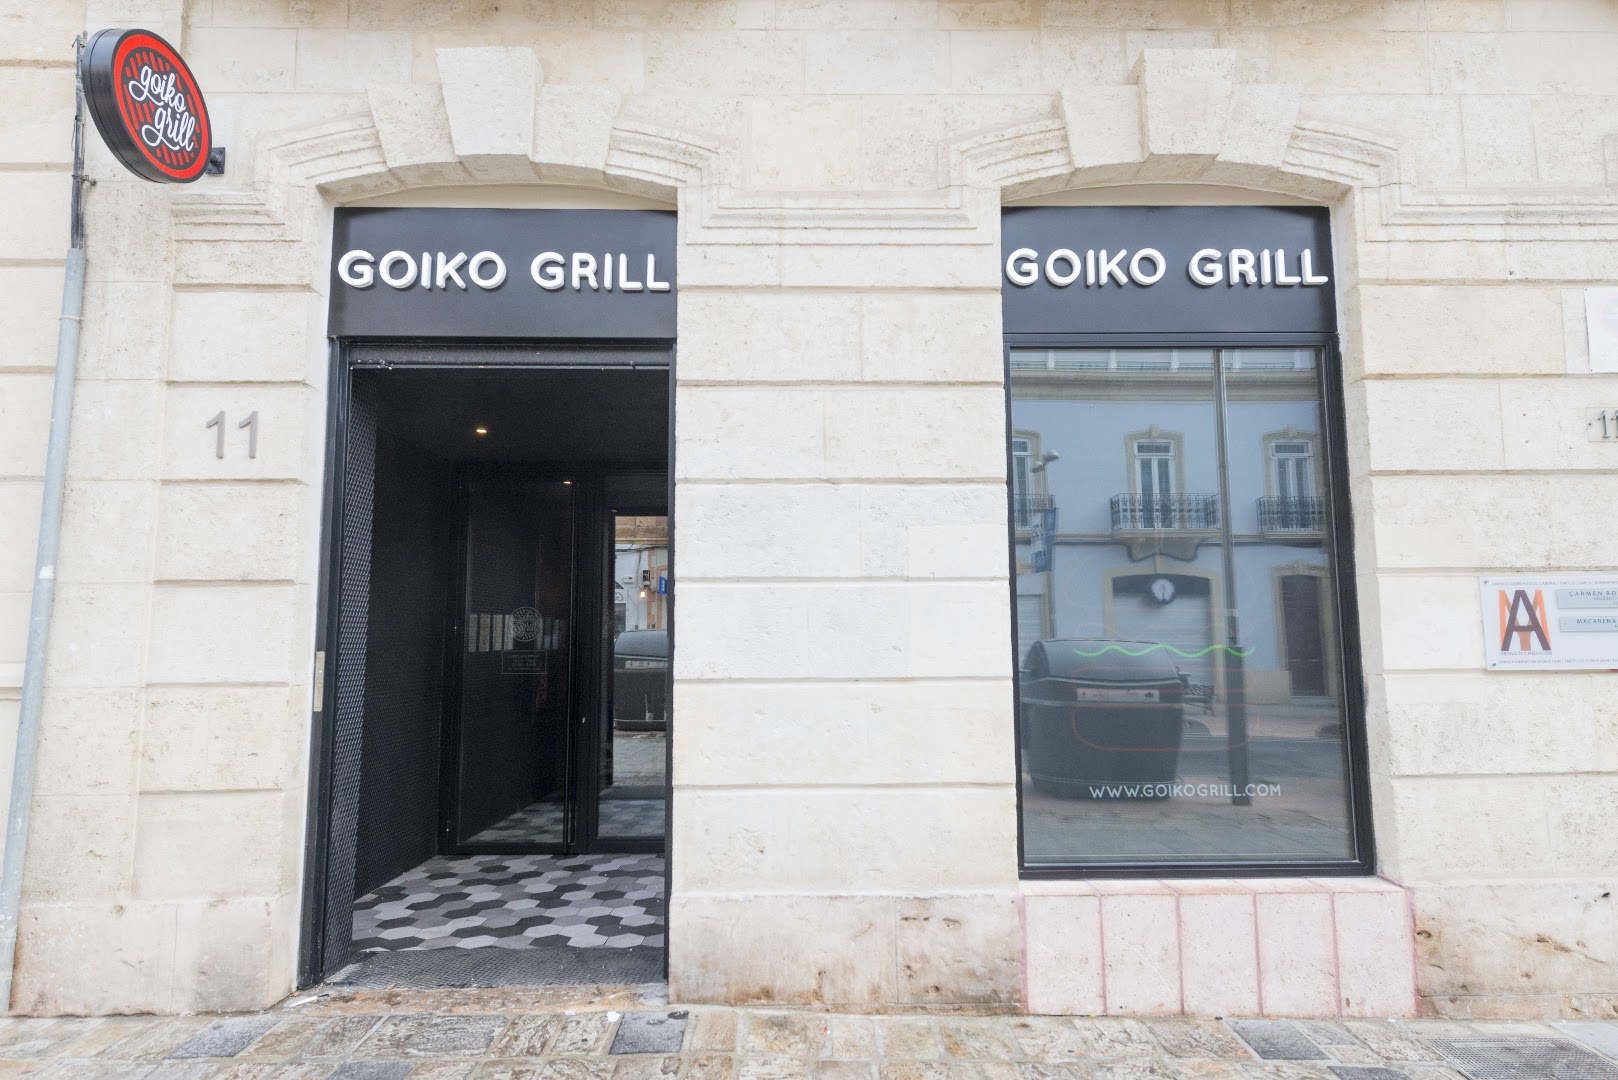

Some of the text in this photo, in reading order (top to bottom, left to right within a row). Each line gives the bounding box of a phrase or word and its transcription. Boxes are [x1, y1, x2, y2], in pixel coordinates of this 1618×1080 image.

[128, 65, 186, 113] goiko
[141, 107, 196, 152] grill
[338, 249, 671, 292] GOIKO GRILL
[1005, 247, 1329, 287] GOIKO GRILL
[206, 410, 259, 459] 11
[1089, 783, 1281, 799] WWW.GOIKOGRILL.COM
